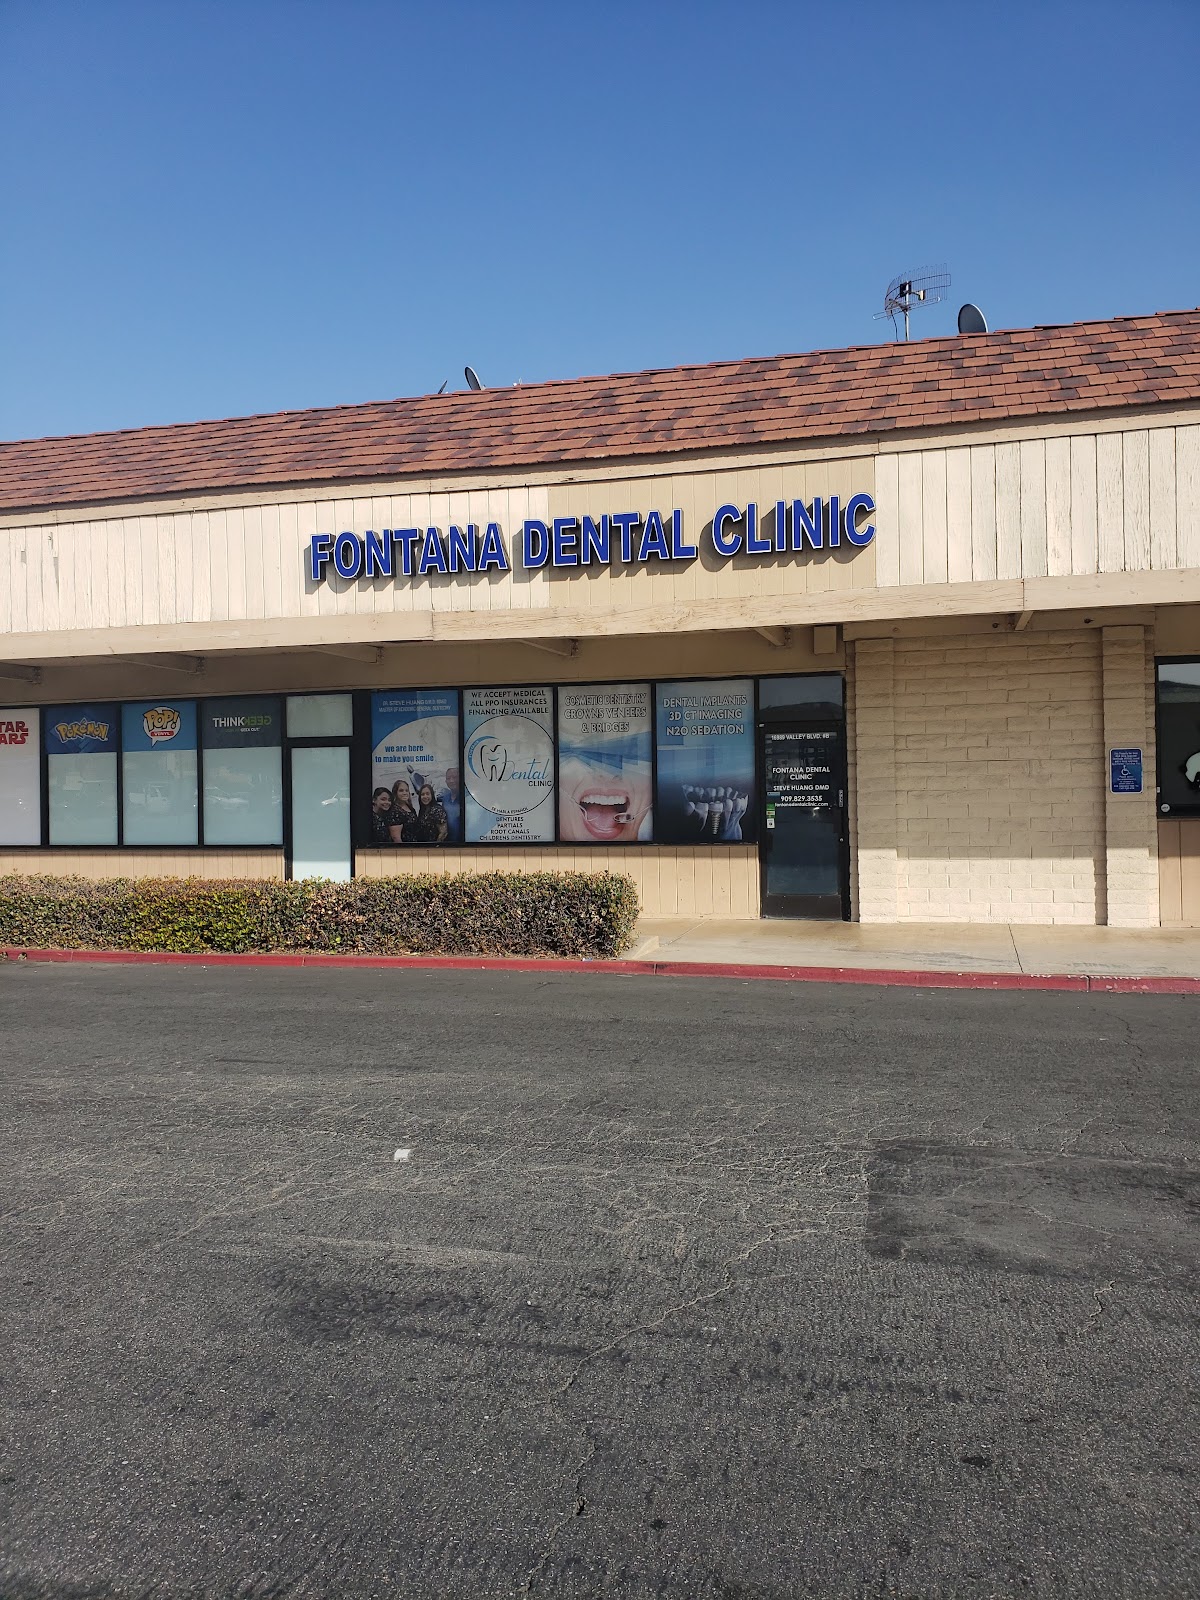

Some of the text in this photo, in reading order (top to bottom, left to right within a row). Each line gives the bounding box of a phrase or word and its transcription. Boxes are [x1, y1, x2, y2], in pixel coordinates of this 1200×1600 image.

[310, 492, 877, 581] FONTANA DENTAL CLINIC
[513, 689, 546, 697] MEDICAL
[565, 692, 647, 706] COSMETIC DENTISTRY
[501, 697, 547, 706] INSURANCES
[663, 694, 747, 708] DENTAL IMPLANTS
[468, 707, 549, 716] FINANCING AVAILABLE
[564, 706, 647, 719] CROWNS VENEERS
[669, 708, 742, 721] 3D CT IMAGING
[0, 721, 28, 732] TAR
[143, 709, 180, 732] POP!
[581, 721, 630, 733] & BRIDGES
[666, 724, 744, 736] N2O SEDATION
[0, 733, 28, 745] ARS
[383, 755, 401, 763] make
[402, 755, 415, 763] you
[415, 754, 434, 762] smile
[502, 758, 550, 781] Dental
